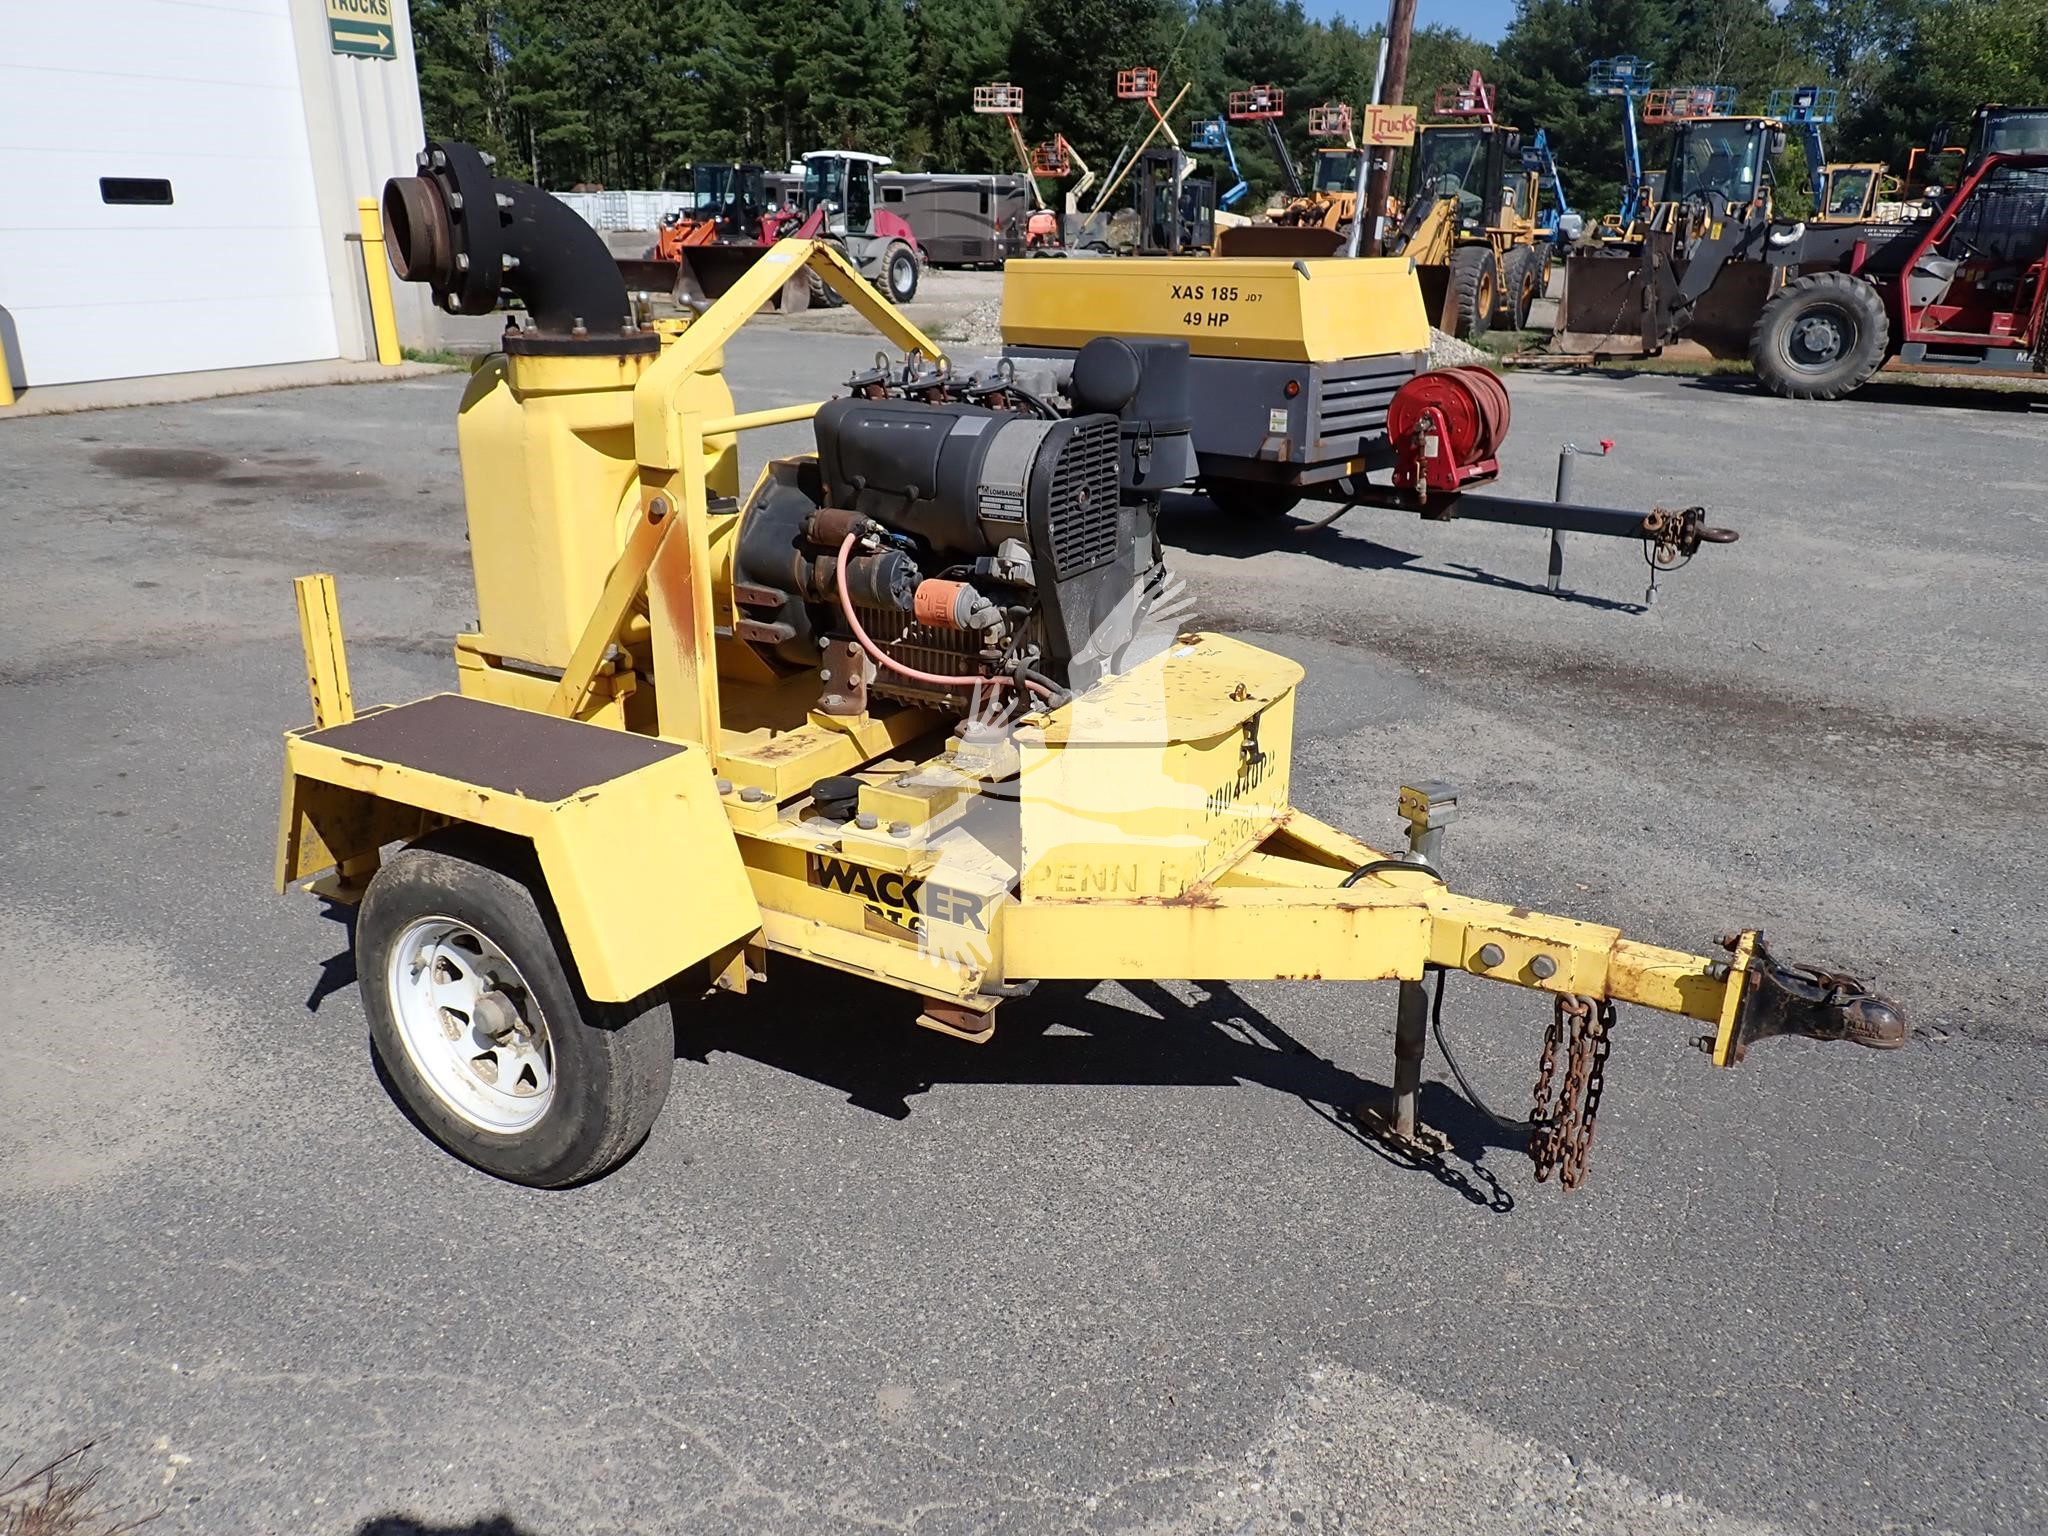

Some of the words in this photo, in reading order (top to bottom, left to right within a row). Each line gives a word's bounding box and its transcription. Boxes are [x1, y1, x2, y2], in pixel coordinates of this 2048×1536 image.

[331, 0, 388, 16] TRUCKS
[1171, 285, 1204, 300] XAS
[1211, 287, 1238, 301] 185
[1245, 293, 1263, 302] JD7
[1183, 312, 1202, 326] 49
[1207, 312, 1229, 327] HP
[818, 854, 986, 932] WACKER
